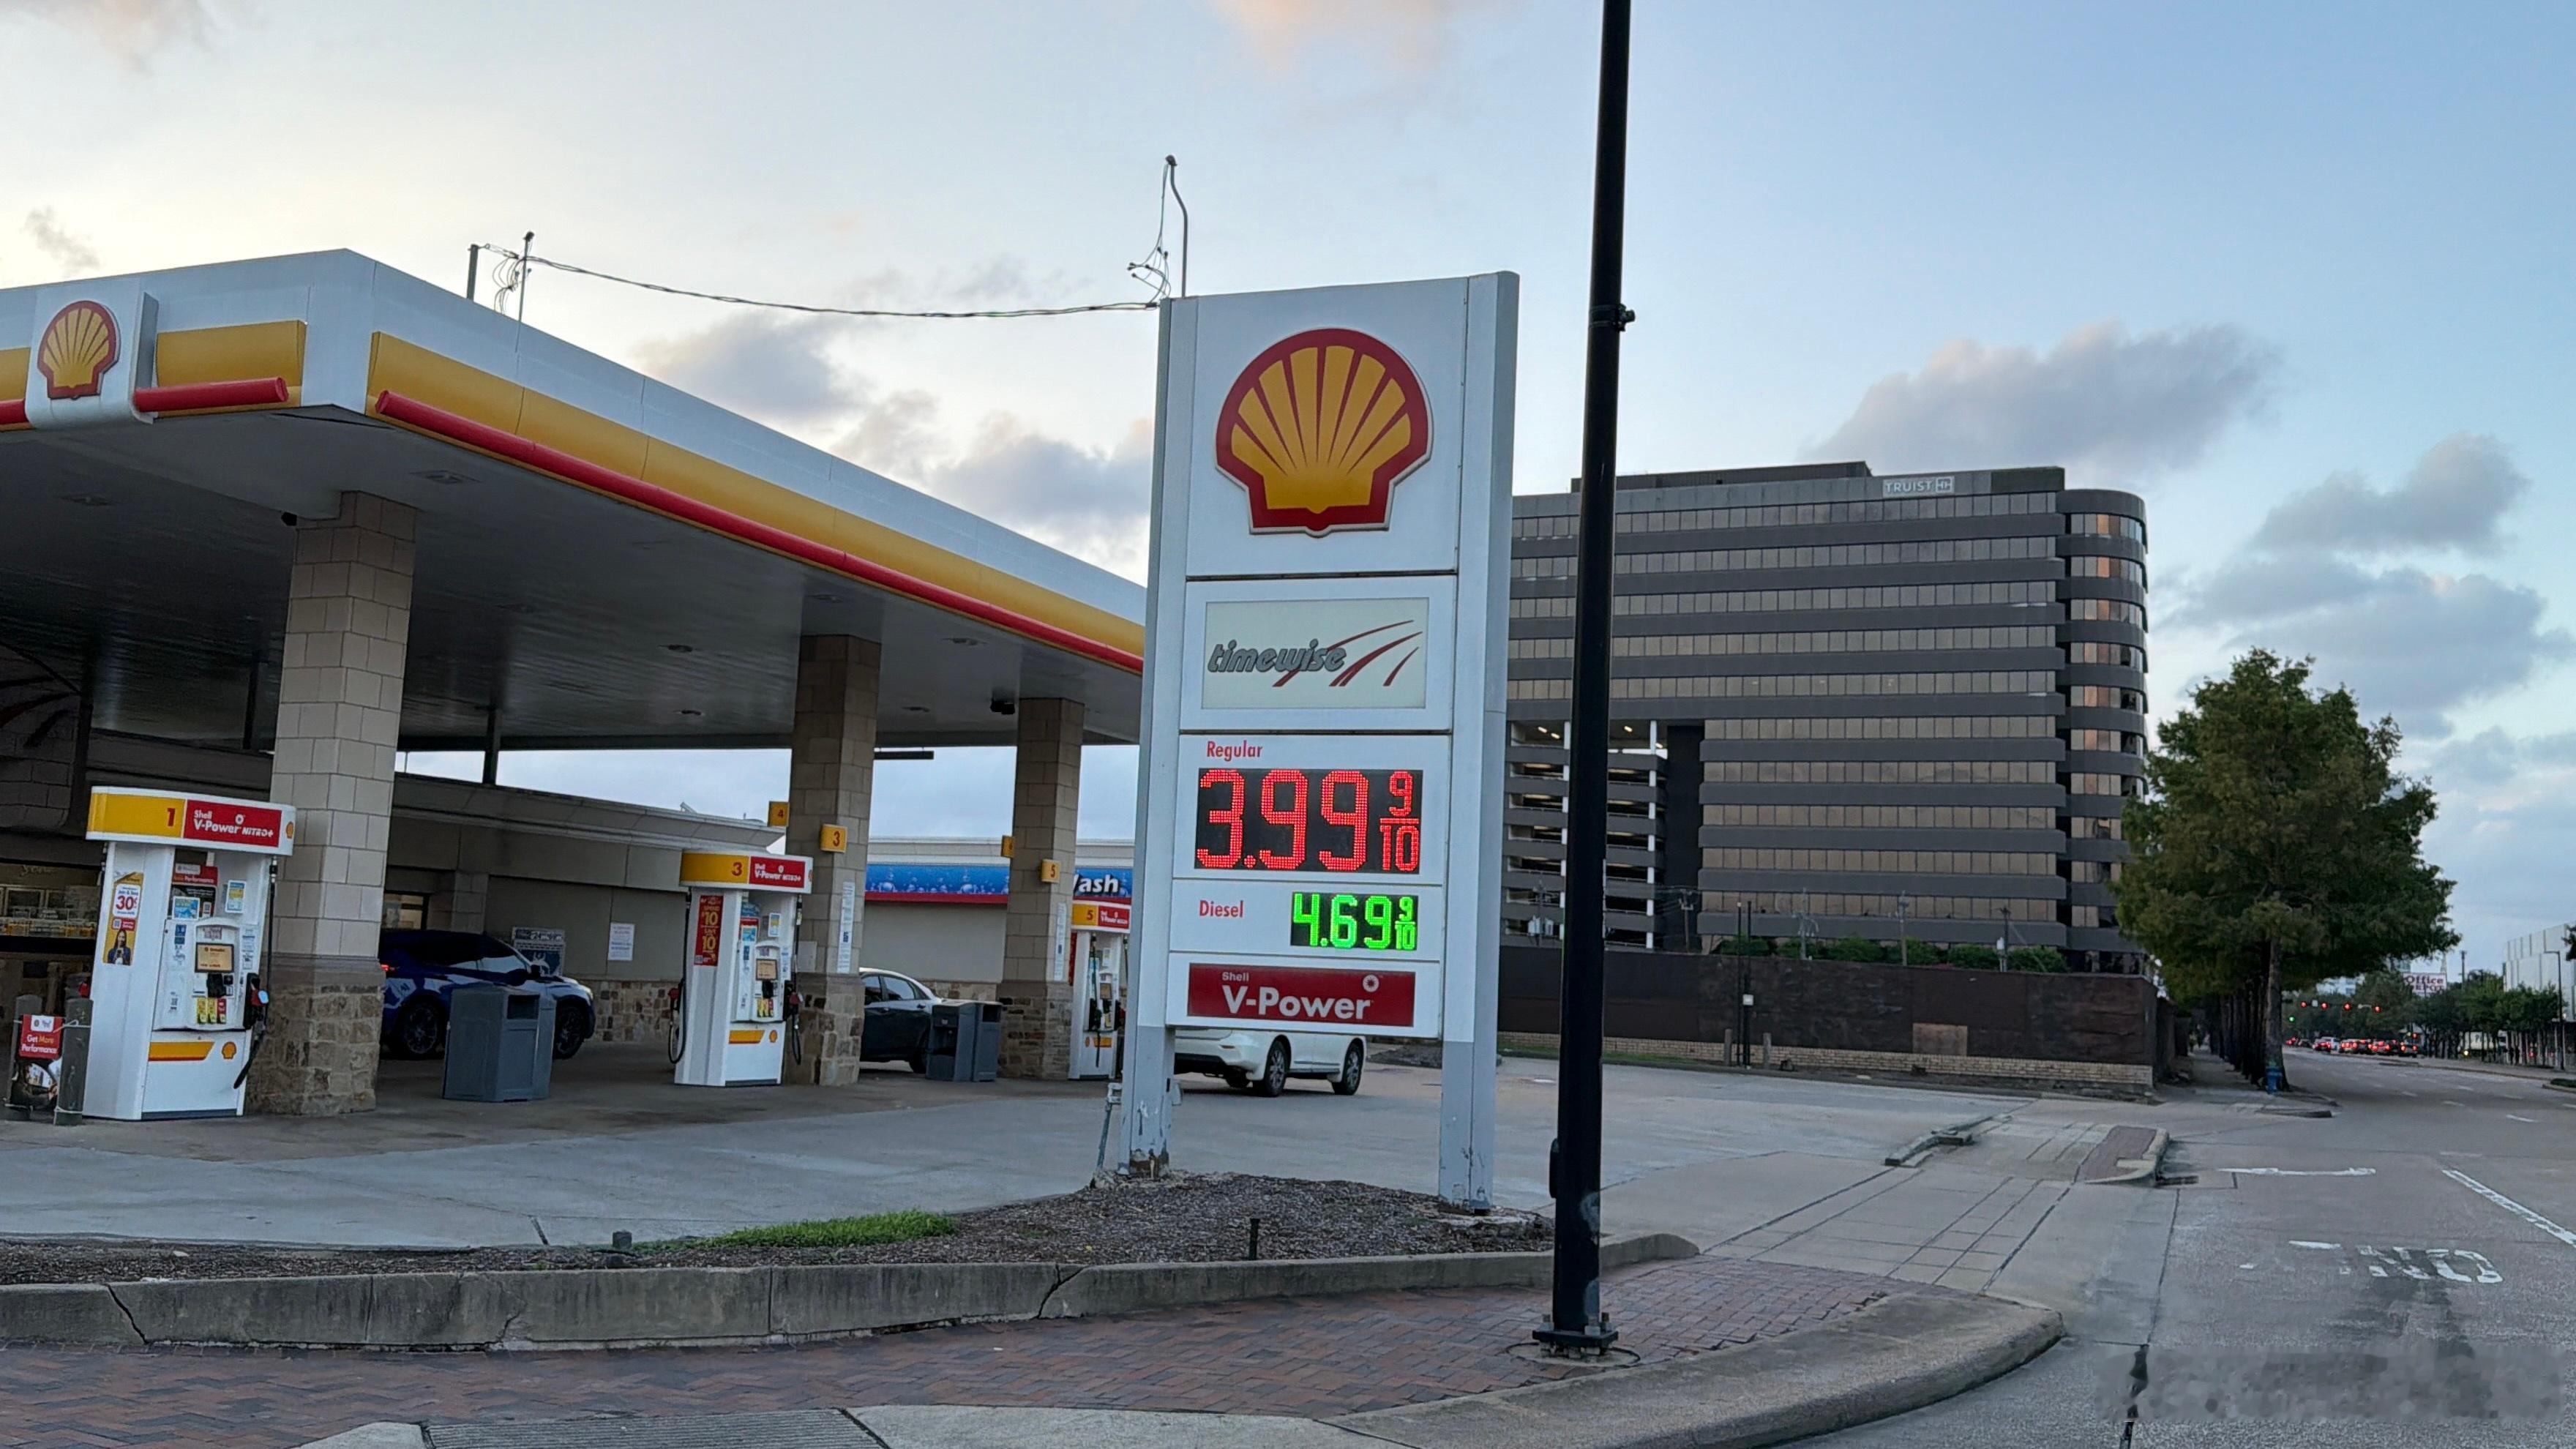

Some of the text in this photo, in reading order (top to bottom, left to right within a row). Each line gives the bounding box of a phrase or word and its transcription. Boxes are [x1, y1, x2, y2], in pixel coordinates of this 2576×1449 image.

[1885, 480, 1932, 493] TRUIST
[1208, 638, 1347, 673] timewise
[1206, 740, 1264, 762] Regular
[167, 807, 176, 827] 1
[193, 809, 213, 821] Shell
[778, 809, 785, 818] 4
[1197, 769, 1369, 872] 3.99
[193, 818, 239, 834] V-Power
[833, 830, 841, 847] 3
[731, 861, 744, 877] 3
[755, 869, 782, 880] V-Power
[1050, 864, 1056, 879] 5
[1087, 910, 1094, 921] 5
[1199, 899, 1245, 918] Diesel
[1292, 893, 1392, 950] 4.69
[1221, 971, 1250, 982] Shell
[2406, 976, 2444, 984] Office
[1221, 985, 1371, 1020] V-Power
[26, 1034, 38, 1043] Get
